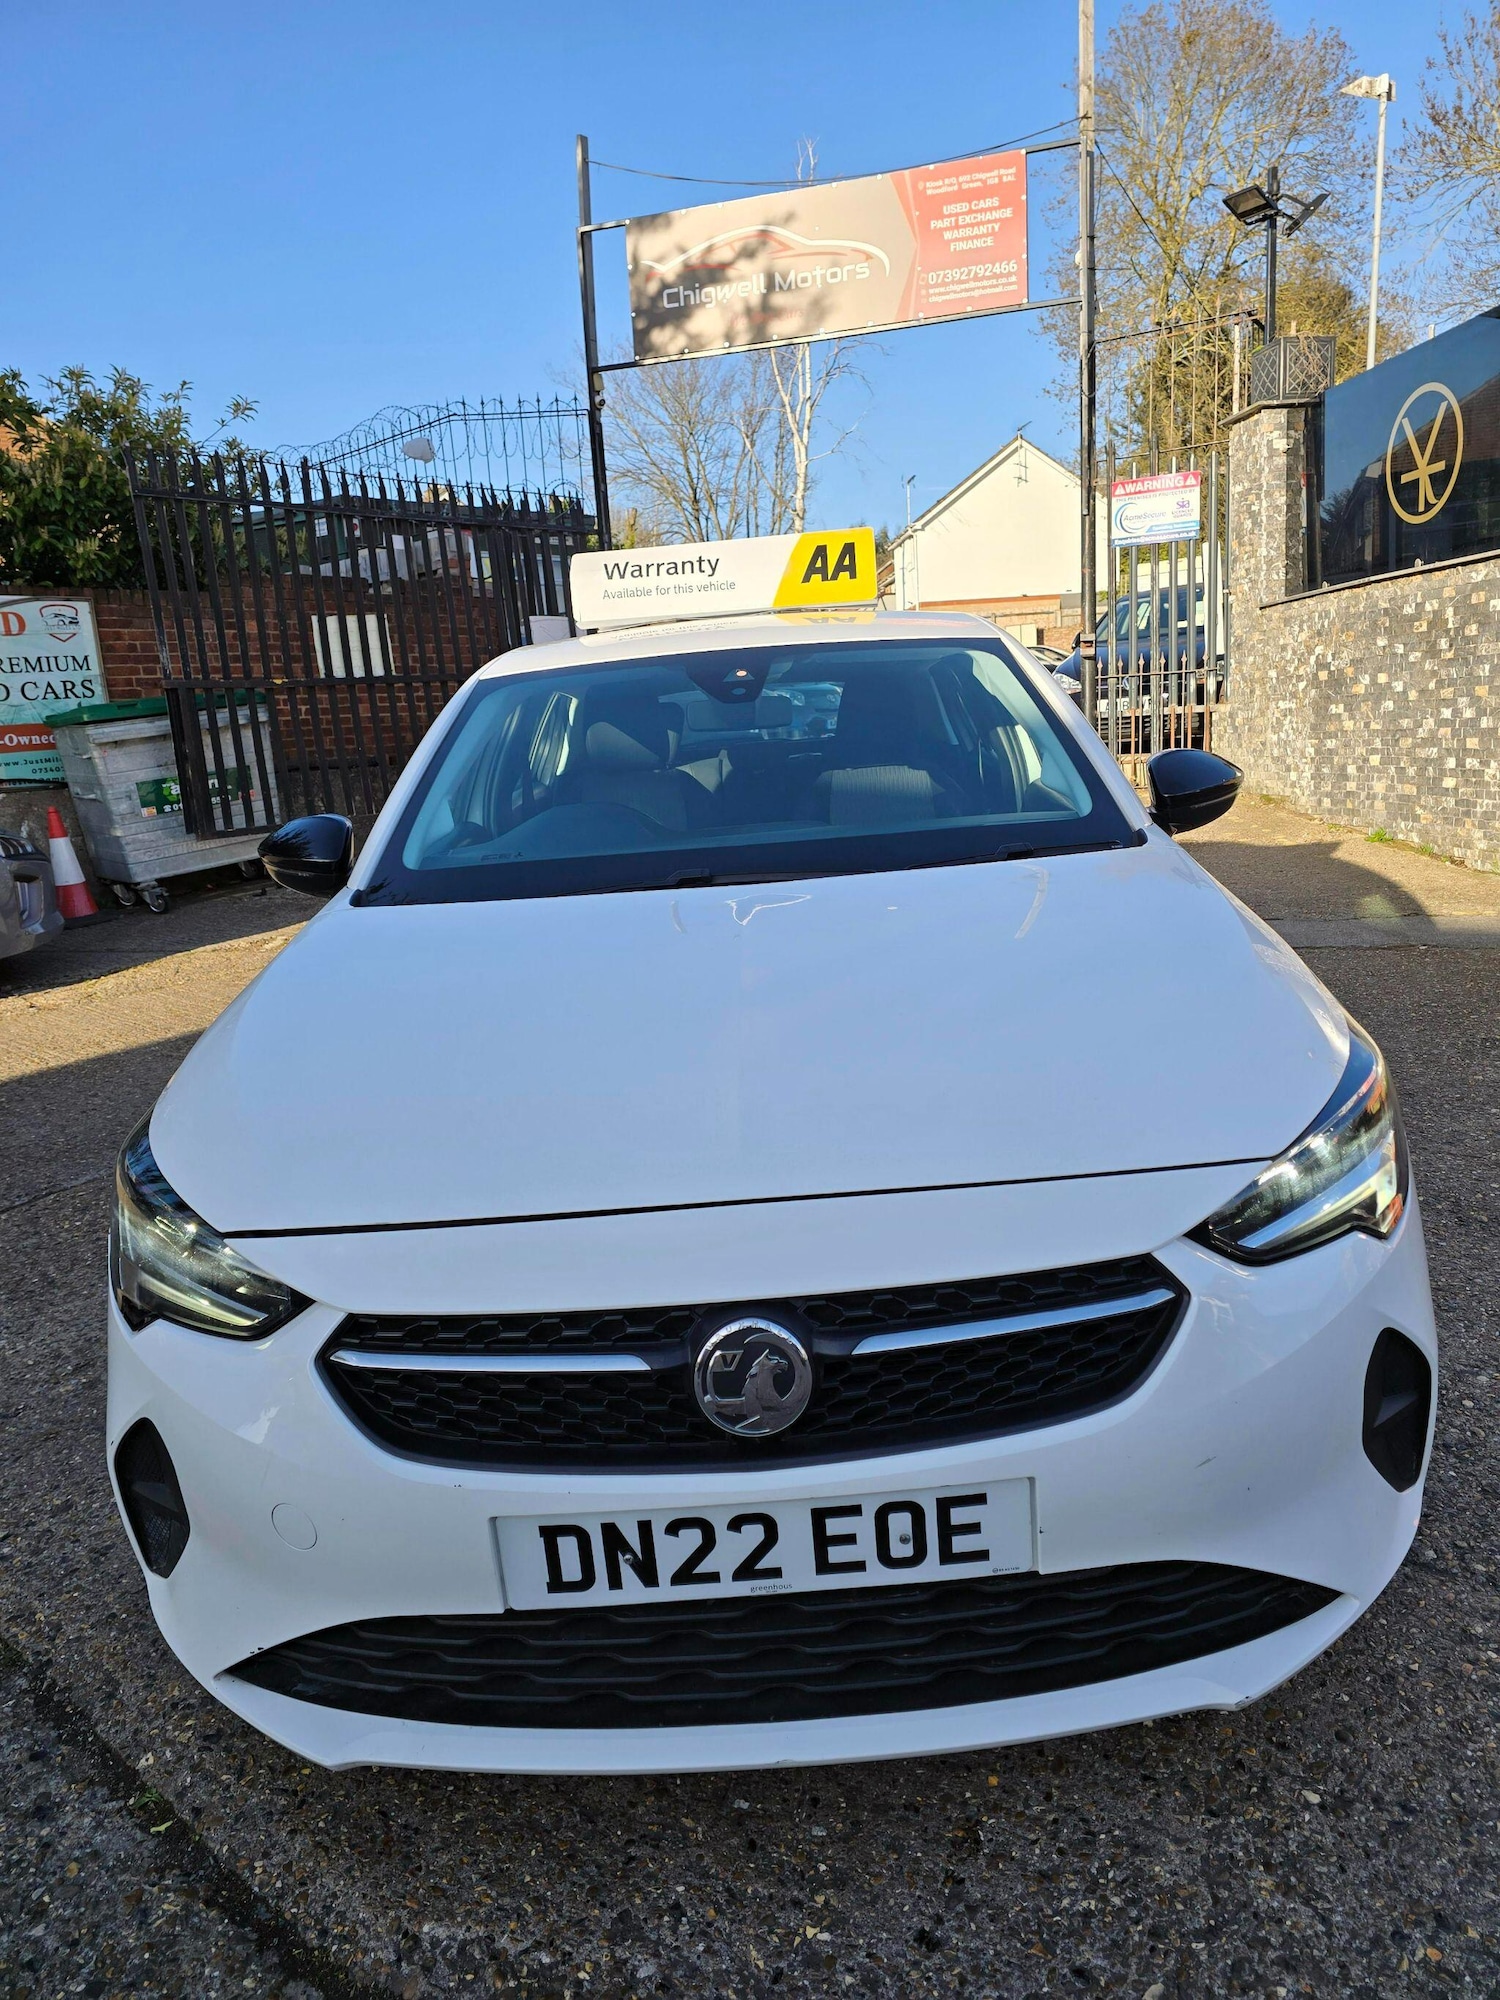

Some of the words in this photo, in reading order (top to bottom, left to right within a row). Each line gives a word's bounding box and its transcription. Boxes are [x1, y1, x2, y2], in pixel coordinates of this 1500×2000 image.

[972, 169, 999, 180] Chigwell
[999, 166, 1016, 175] Road
[926, 184, 958, 195] Woodford
[943, 202, 969, 215] USED
[971, 197, 999, 210] CARS
[930, 217, 956, 230] PART
[958, 208, 1014, 225] EXCHANGE
[943, 223, 1001, 240] WARRANTY
[950, 237, 994, 252] FINANCE
[928, 260, 1018, 284] 07392792466
[662, 273, 768, 309] Chigwell
[774, 262, 870, 292] Motors
[928, 275, 1017, 294] www.chigwellmotors.co.uk
[1124, 476, 1185, 494] WARNING
[603, 555, 720, 580] Warranty
[801, 542, 857, 584] AA
[603, 586, 653, 600] Available
[656, 585, 671, 596] for
[673, 583, 694, 595] this
[696, 580, 736, 592] vehicle
[20, 679, 95, 701] CARS
[538, 1512, 783, 1594] DN22
[810, 1492, 990, 1576] EOE
[750, 1583, 793, 1593] greenhous
